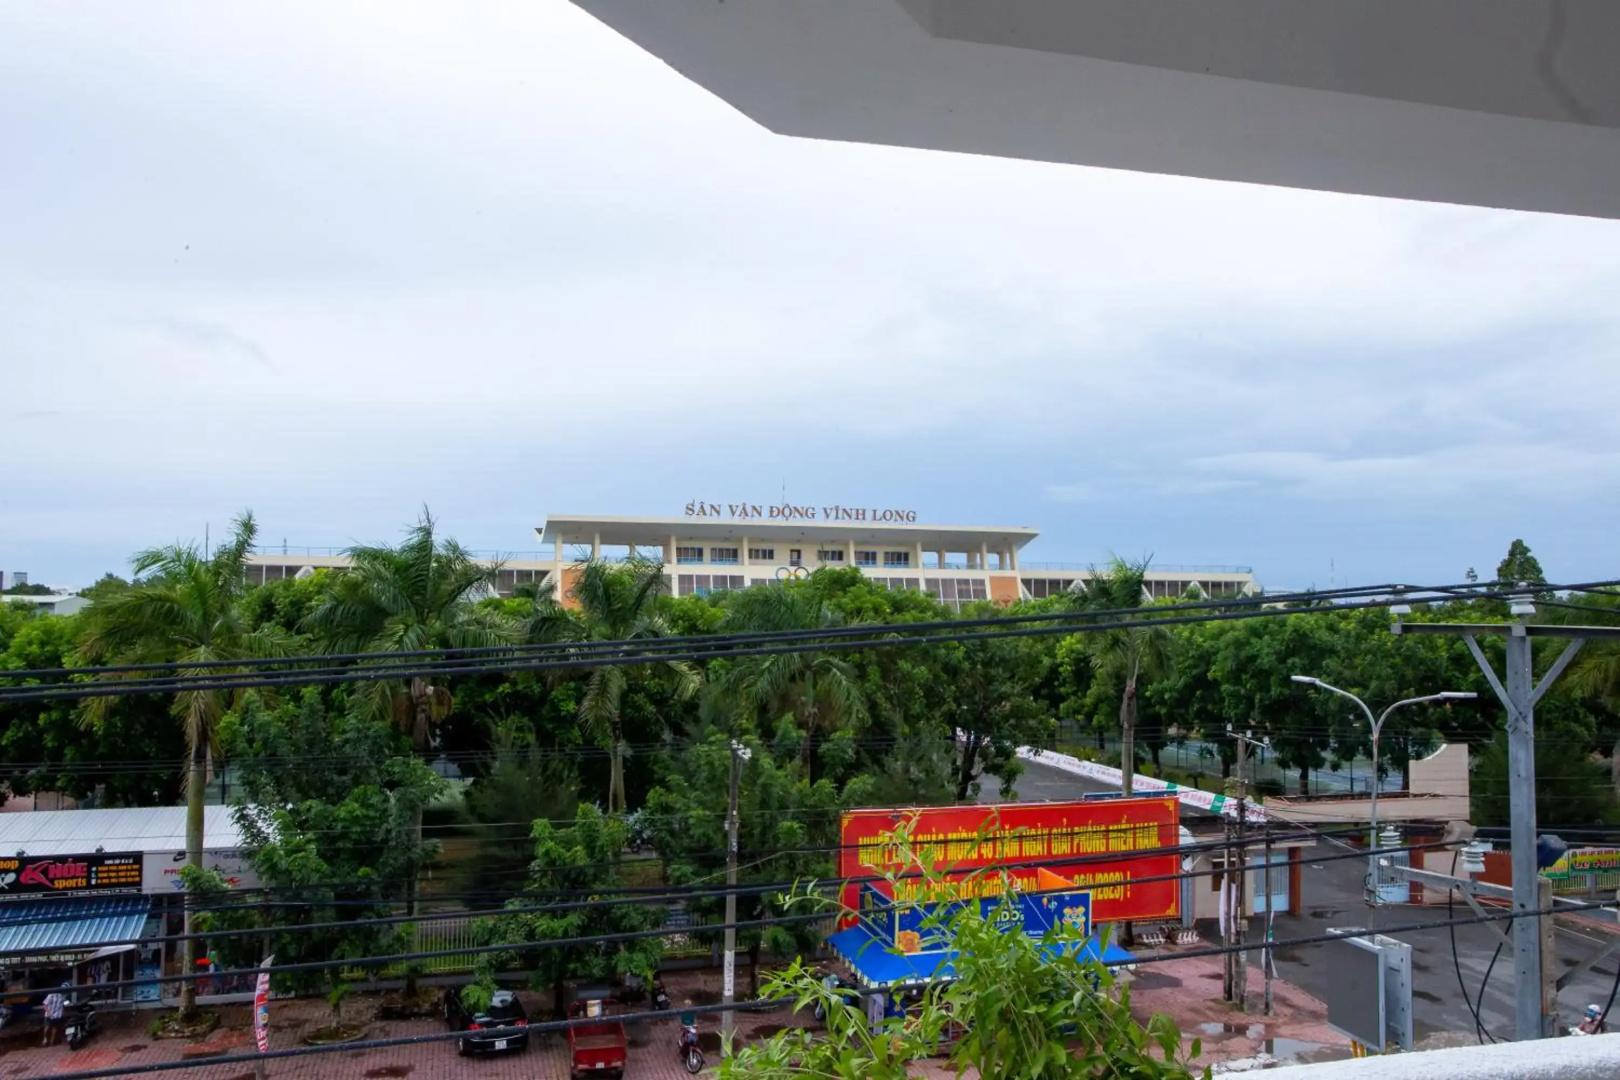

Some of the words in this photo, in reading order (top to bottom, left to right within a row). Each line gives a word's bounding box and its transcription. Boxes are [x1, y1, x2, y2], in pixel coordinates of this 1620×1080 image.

[685, 501, 721, 516] SÂN
[728, 503, 763, 520] VẬN
[768, 503, 816, 521] ĐỘNG
[823, 507, 866, 521] VĨNH
[872, 509, 917, 523] LONG
[1073, 820, 1106, 854] PHÓNG
[1109, 815, 1134, 851] MIỀN
[53, 878, 87, 889] sports
